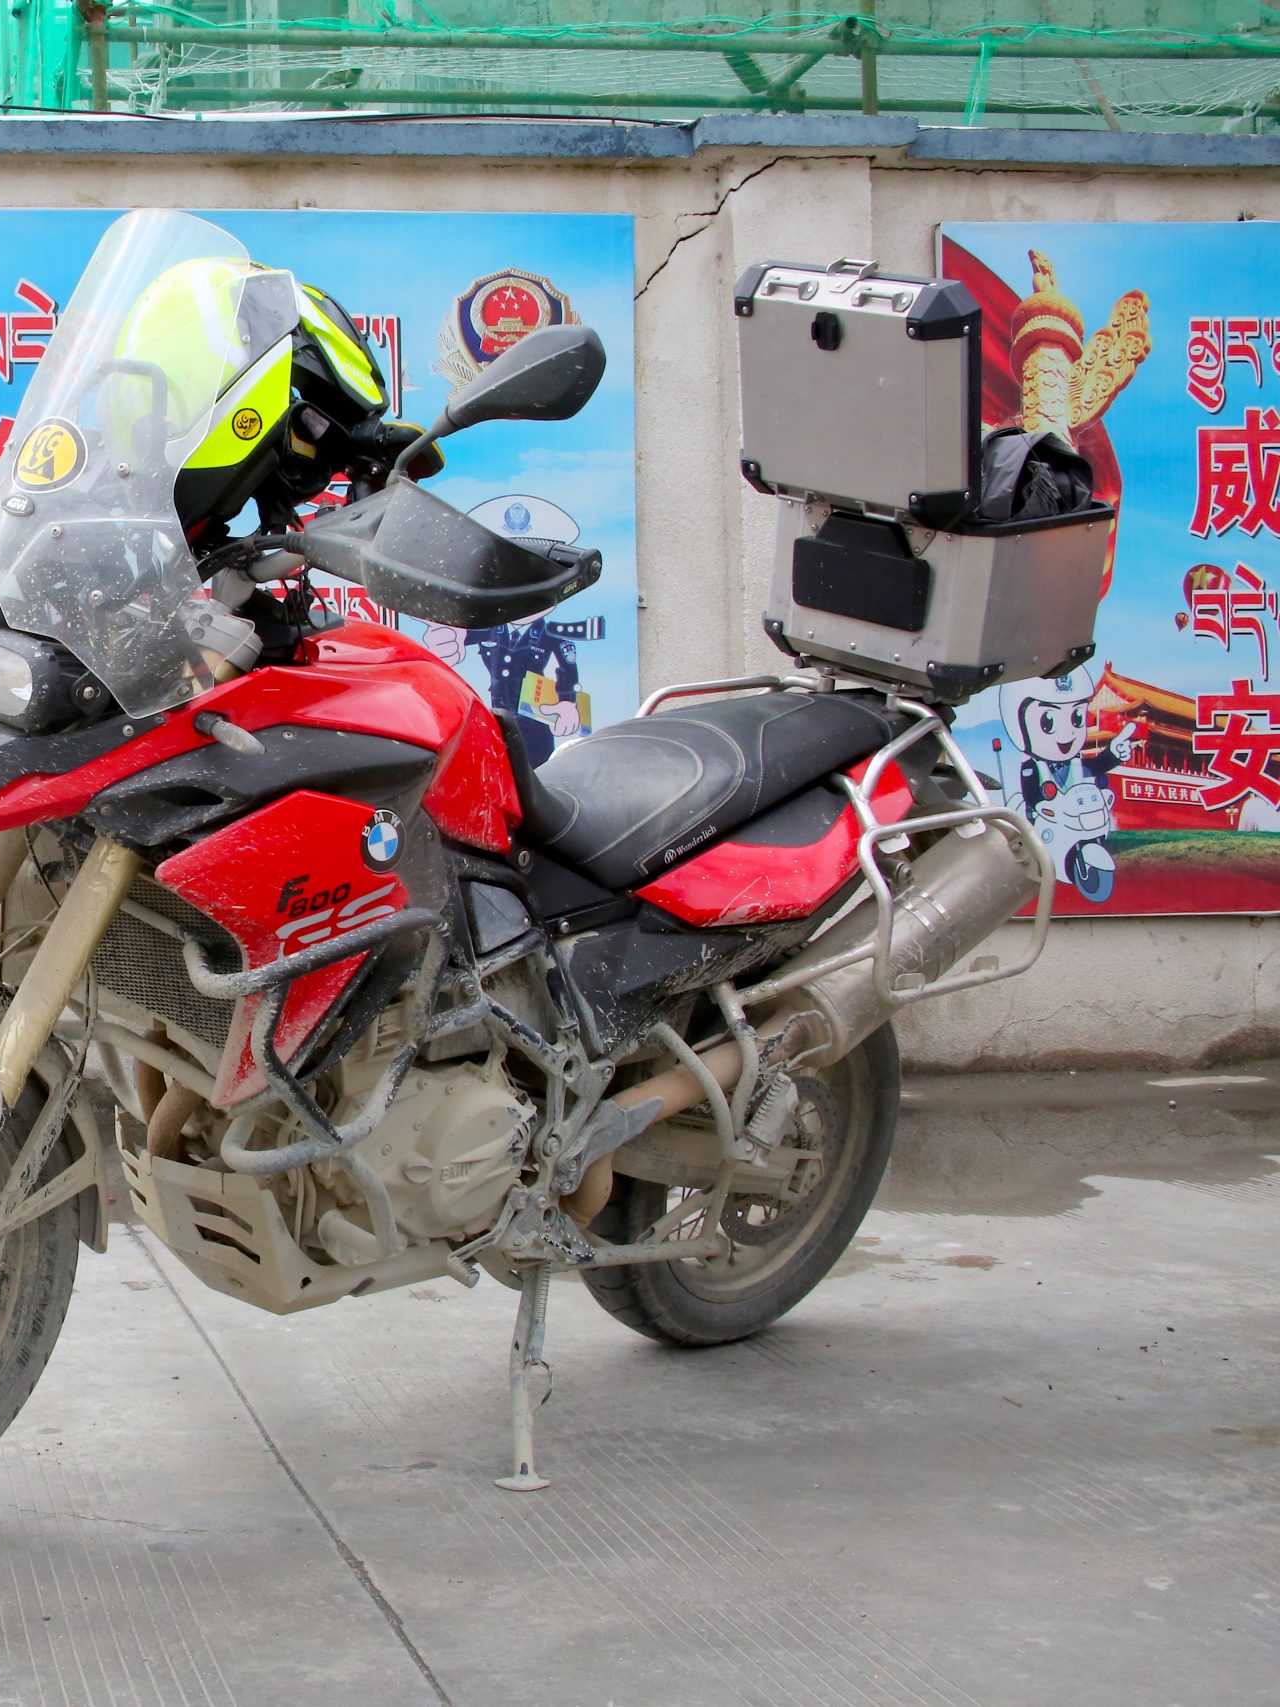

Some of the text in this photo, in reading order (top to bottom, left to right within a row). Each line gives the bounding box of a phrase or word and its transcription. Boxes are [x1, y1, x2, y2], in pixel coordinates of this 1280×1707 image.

[1188, 406, 1280, 540] 威
[1192, 678, 1280, 812] 安
[362, 812, 401, 838] BMW
[676, 825, 717, 856] Wunderlich
[288, 882, 351, 918] 800
